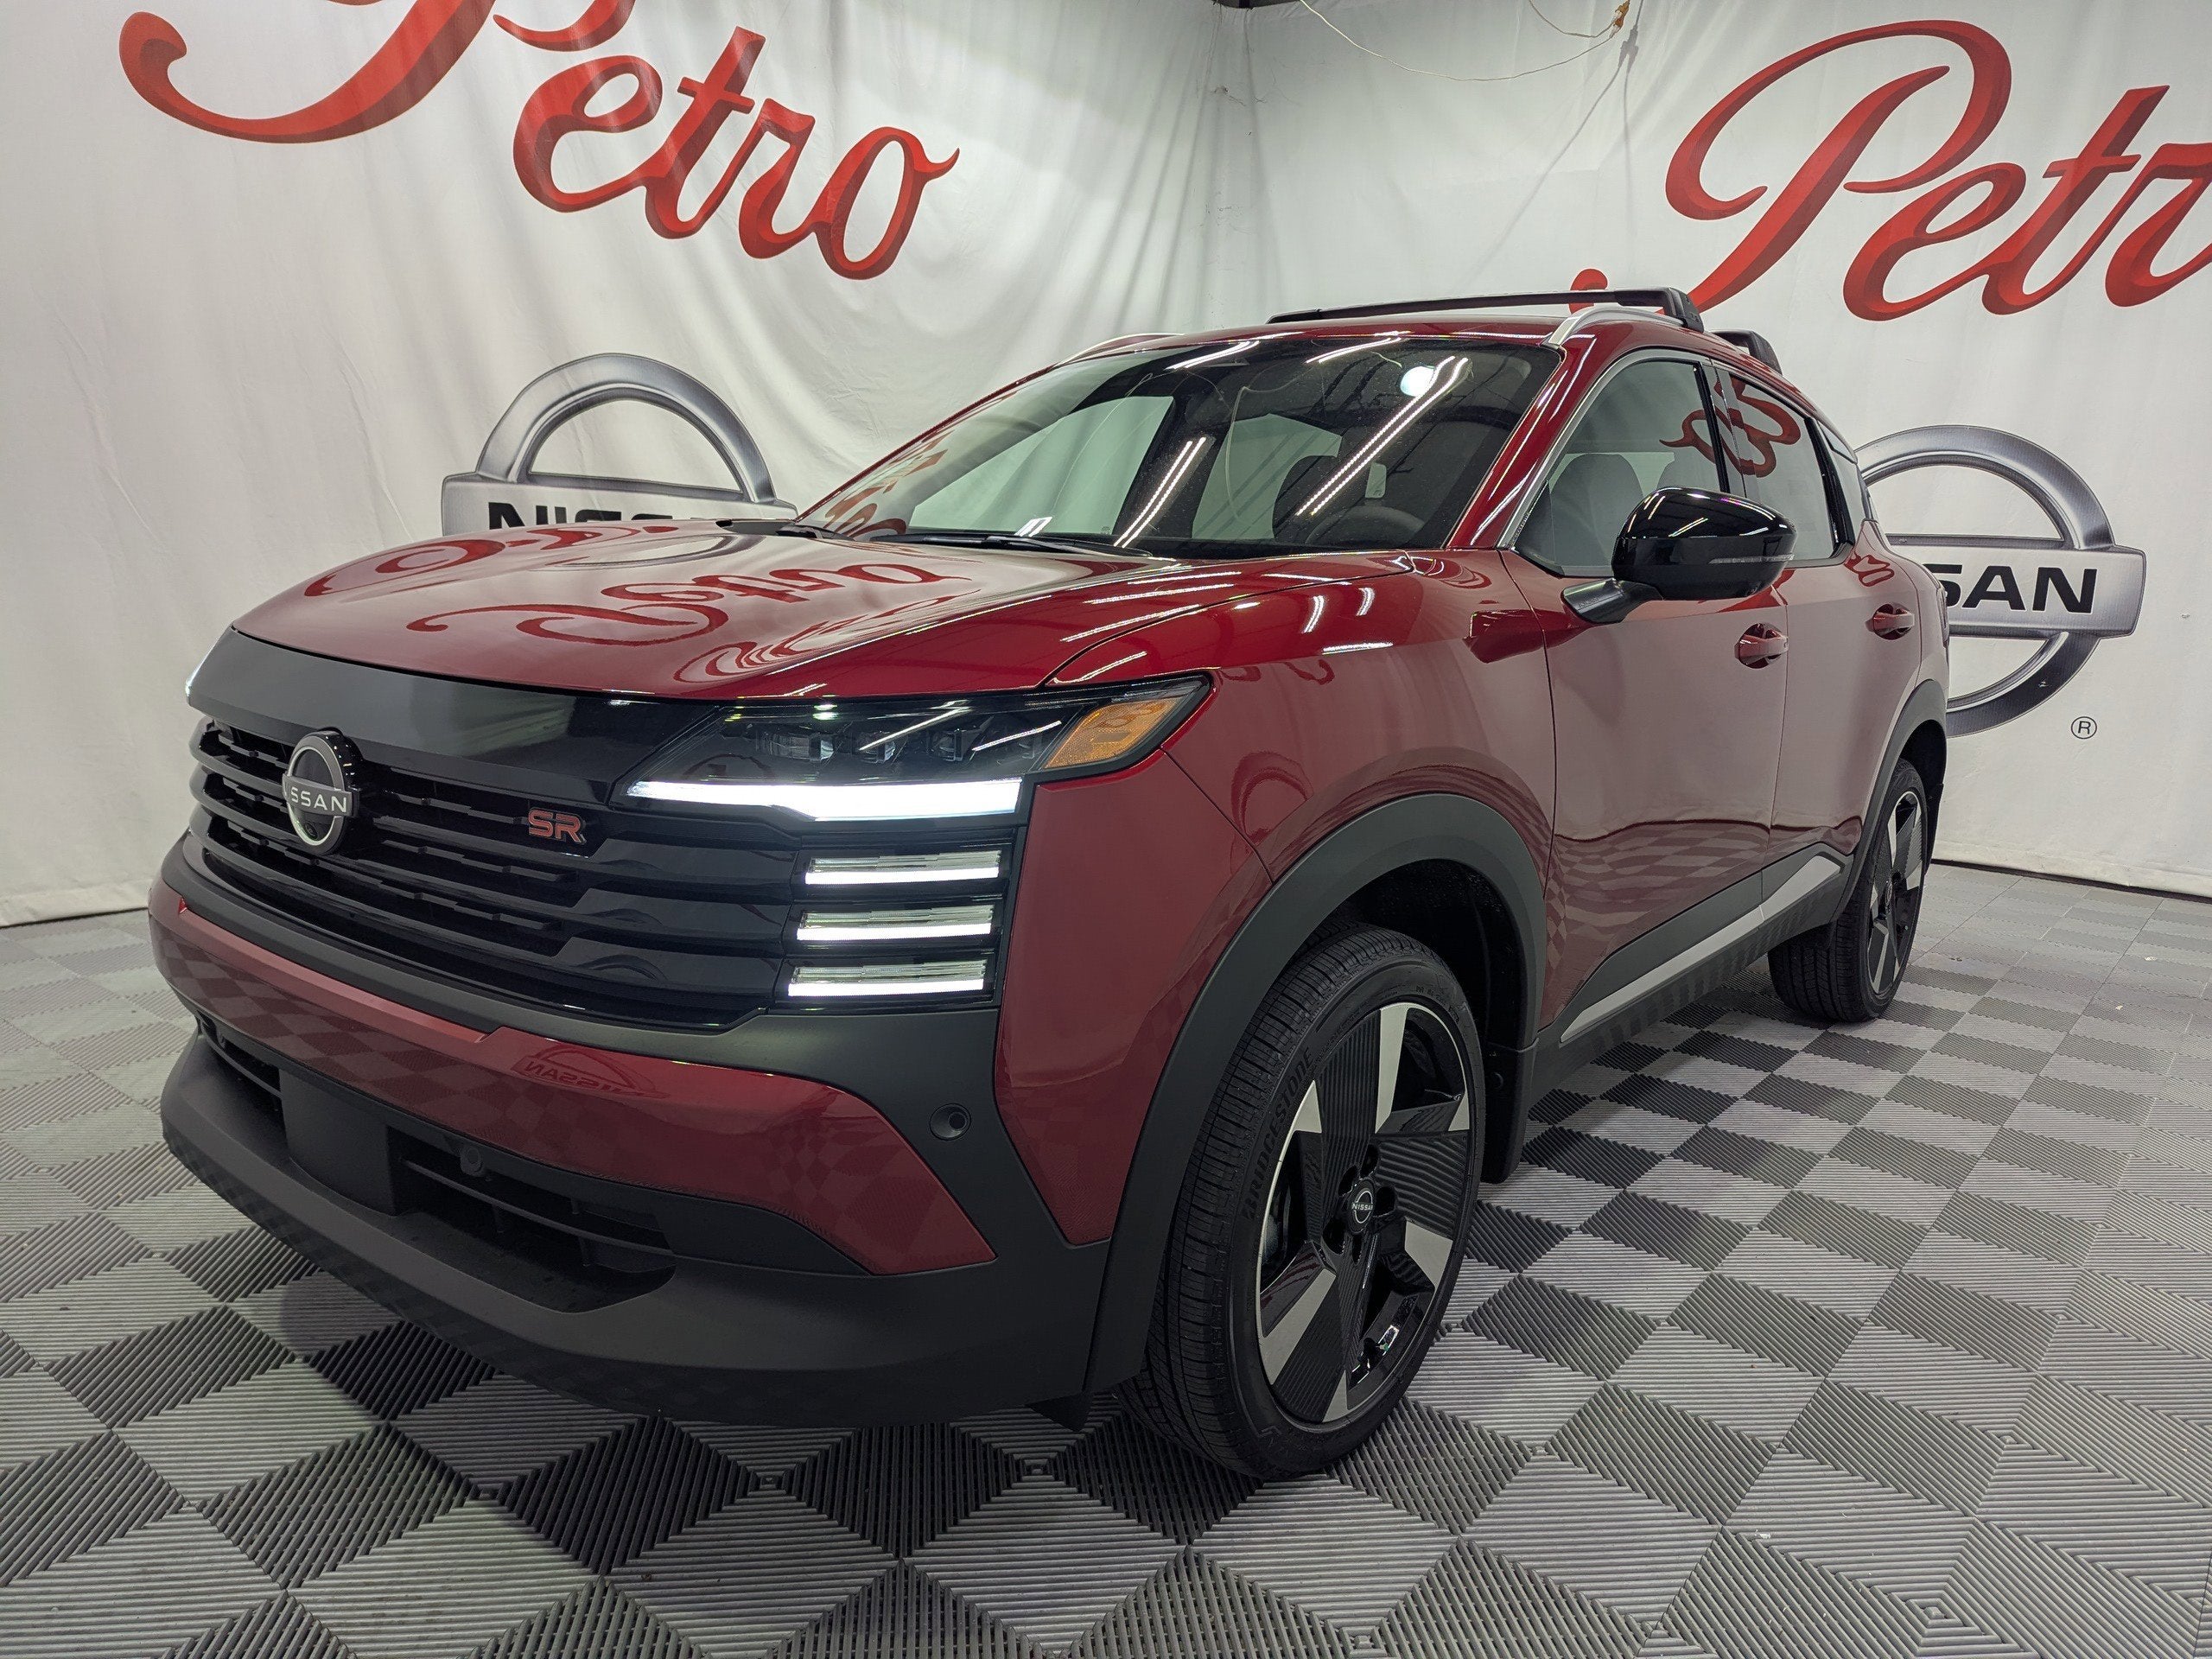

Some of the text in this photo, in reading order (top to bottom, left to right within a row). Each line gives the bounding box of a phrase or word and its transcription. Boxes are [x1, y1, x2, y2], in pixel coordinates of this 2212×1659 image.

[1568, 20, 2212, 321] Petr
[1922, 563, 2098, 613] SAN
[283, 779, 347, 813] ISSAN
[528, 809, 583, 843] SR
